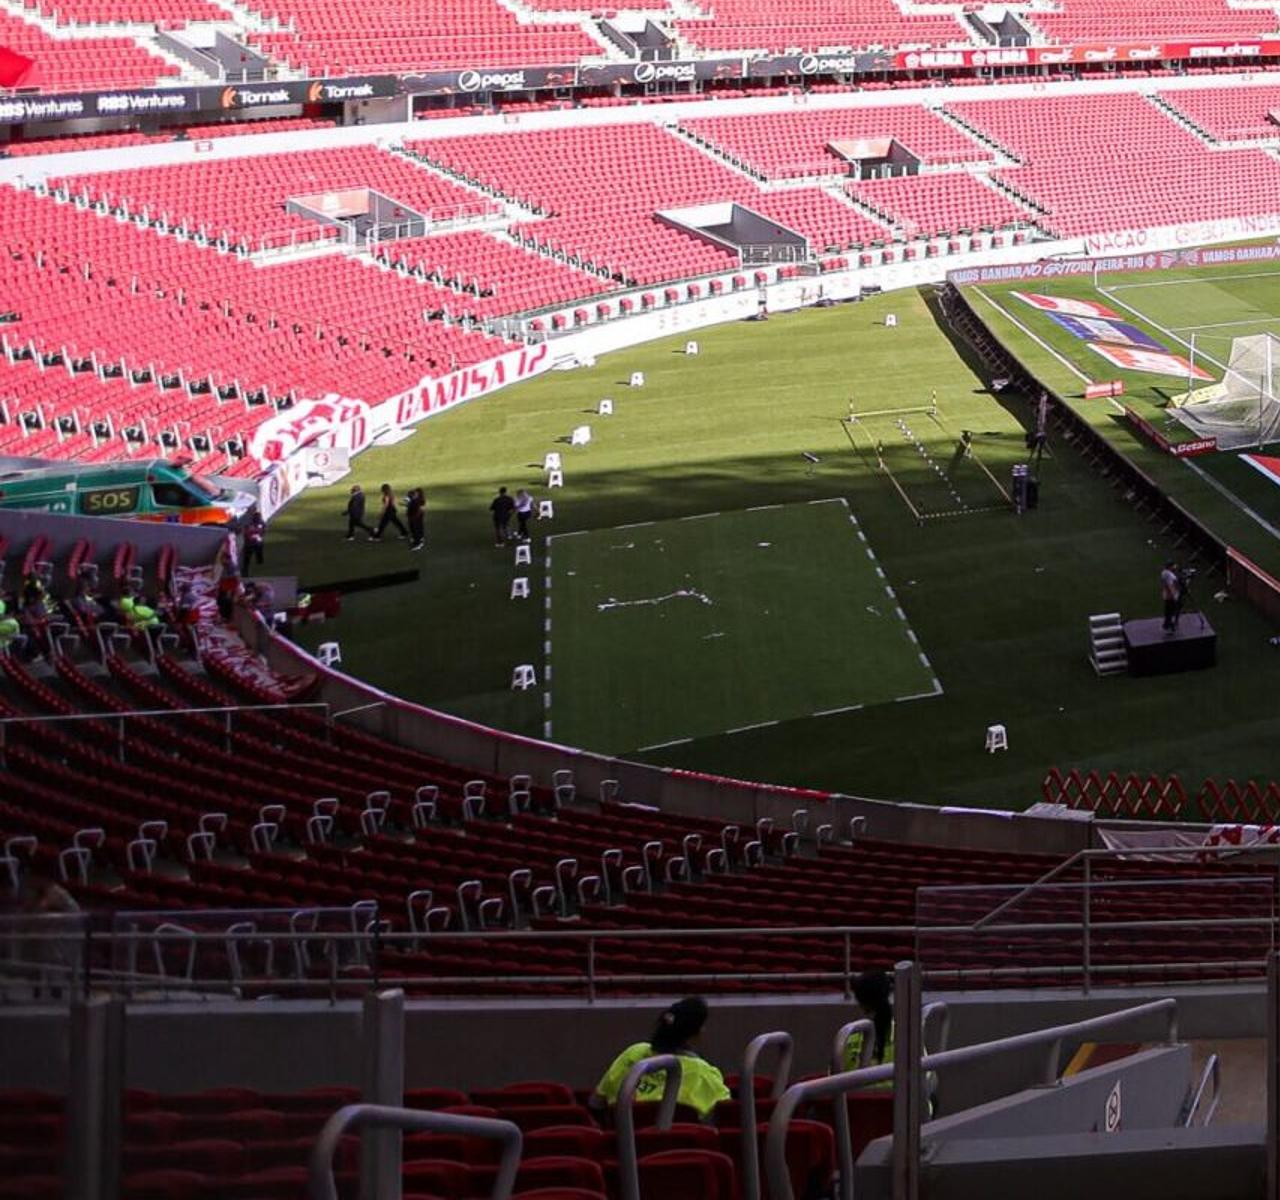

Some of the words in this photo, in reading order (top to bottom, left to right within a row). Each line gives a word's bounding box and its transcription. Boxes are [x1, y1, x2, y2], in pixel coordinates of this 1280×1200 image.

[655, 62, 696, 81] pepsi
[819, 56, 855, 73] pepsi
[481, 70, 525, 89] pepsi
[25, 99, 83, 115] Ventures
[130, 92, 186, 109] Ventures
[1204, 248, 1235, 261] VAMOS
[980, 267, 1023, 280] GANHAR
[1022, 265, 1041, 277] NO
[1042, 262, 1074, 276] GRITO
[1096, 257, 1144, 271] BEIRA-RIO
[396, 361, 505, 425] CAMISA
[1176, 438, 1215, 453] Betano
[88, 490, 131, 510] SOS
